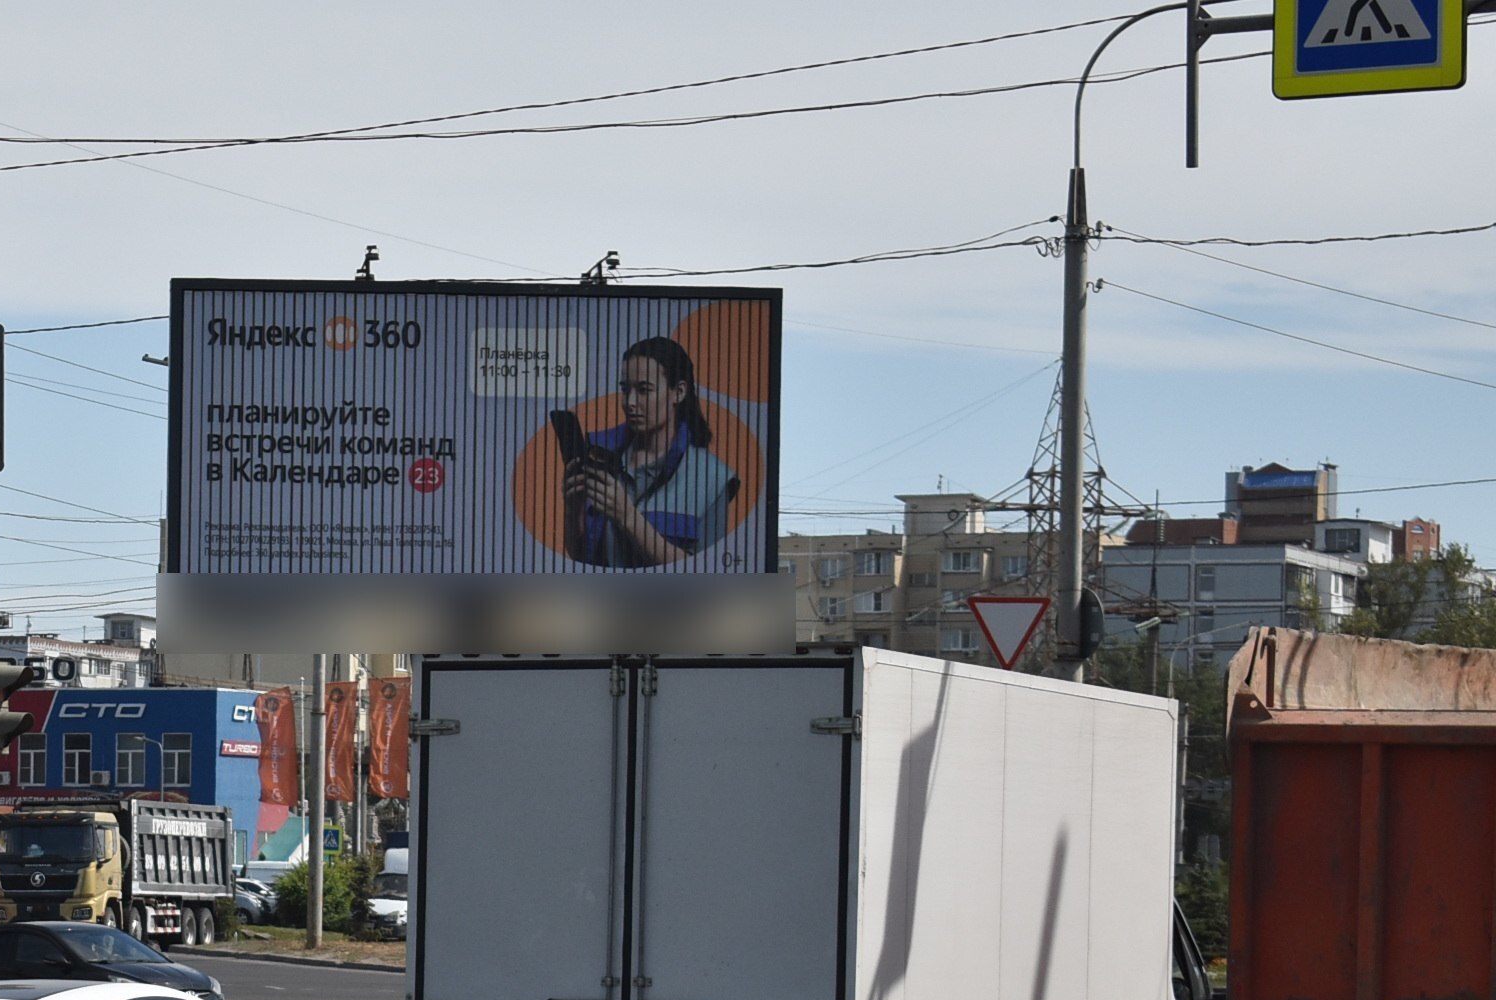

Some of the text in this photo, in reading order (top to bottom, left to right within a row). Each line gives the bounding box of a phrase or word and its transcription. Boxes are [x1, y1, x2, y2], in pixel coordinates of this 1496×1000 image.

[207, 318, 421, 350] Яндекс 360
[480, 347, 549, 363] Планёрка
[480, 365, 518, 378] 11:00
[533, 365, 571, 378] 11:30
[207, 401, 391, 431] планируйте
[206, 434, 456, 461] встречи команд
[206, 457, 400, 489] в Календаре
[414, 467, 440, 485] 23
[721, 552, 743, 568] 0+
[58, 703, 147, 718] СТО
[232, 705, 255, 721] СТ
[223, 743, 258, 755] TURBO
